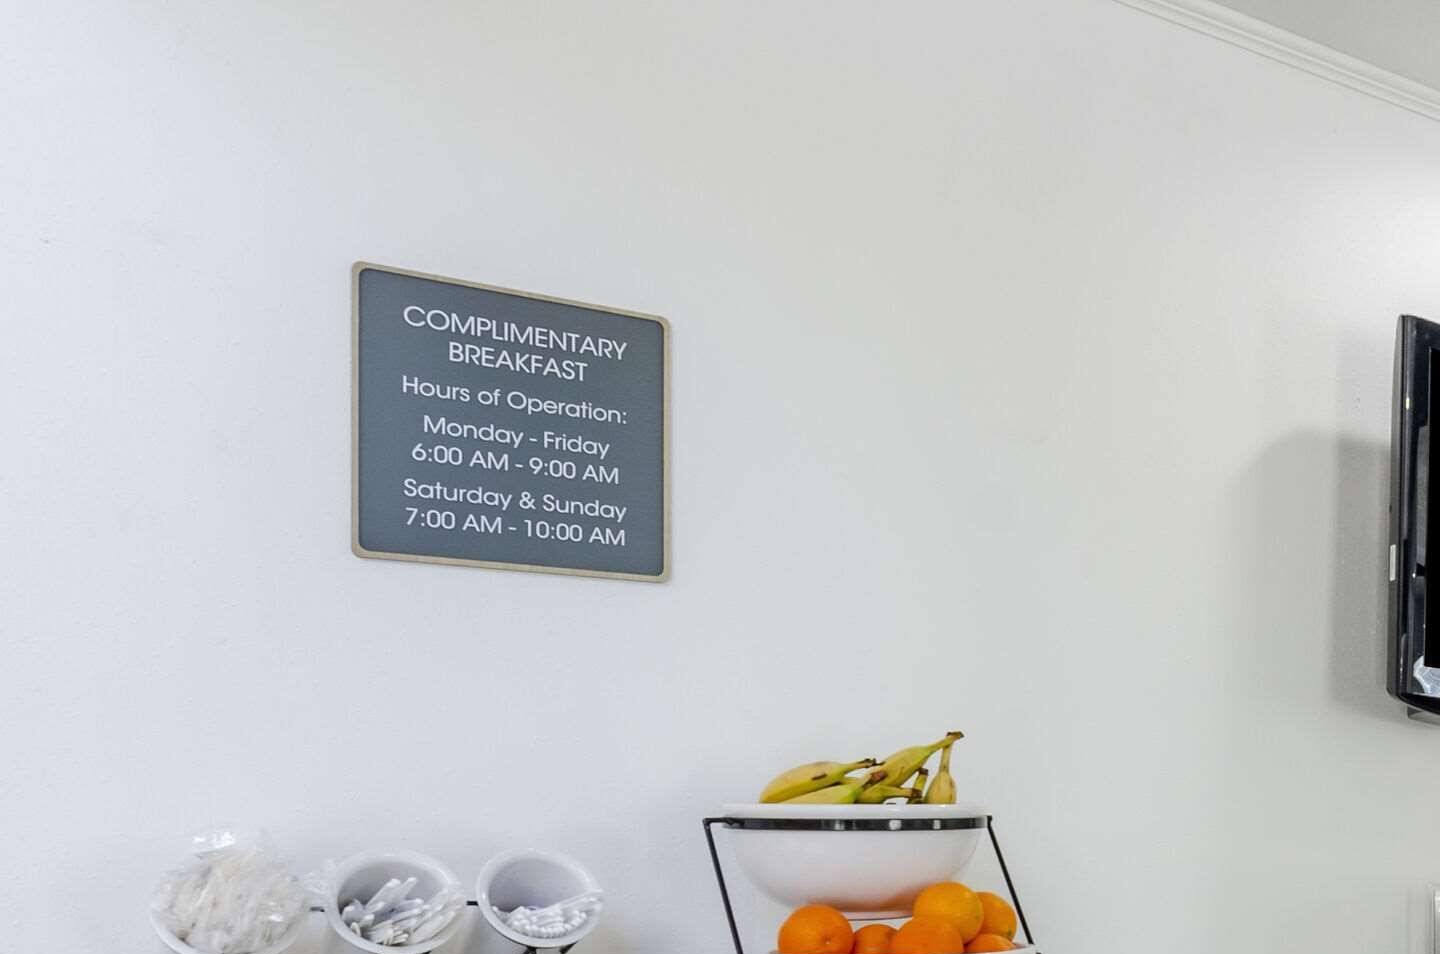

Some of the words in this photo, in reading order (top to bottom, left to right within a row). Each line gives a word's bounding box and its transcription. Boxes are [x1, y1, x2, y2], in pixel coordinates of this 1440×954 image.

[403, 305, 628, 361] COMPLIMENTARY
[448, 341, 589, 382] BREAKFAST
[402, 374, 471, 403] Hours
[477, 388, 501, 407] of
[506, 391, 627, 425] Operation:
[423, 414, 524, 449] Monday
[543, 431, 611, 460] Friday
[411, 442, 463, 466] 6:00
[468, 449, 509, 472] AM
[528, 456, 577, 480] 9:00
[581, 464, 619, 485] AM
[403, 477, 513, 511] Saturday
[518, 491, 537, 510] &
[542, 493, 628, 523] Sunday
[405, 506, 456, 530] 7:00
[461, 513, 502, 535] AM
[523, 519, 583, 542] 10:00
[588, 526, 626, 547] AM
